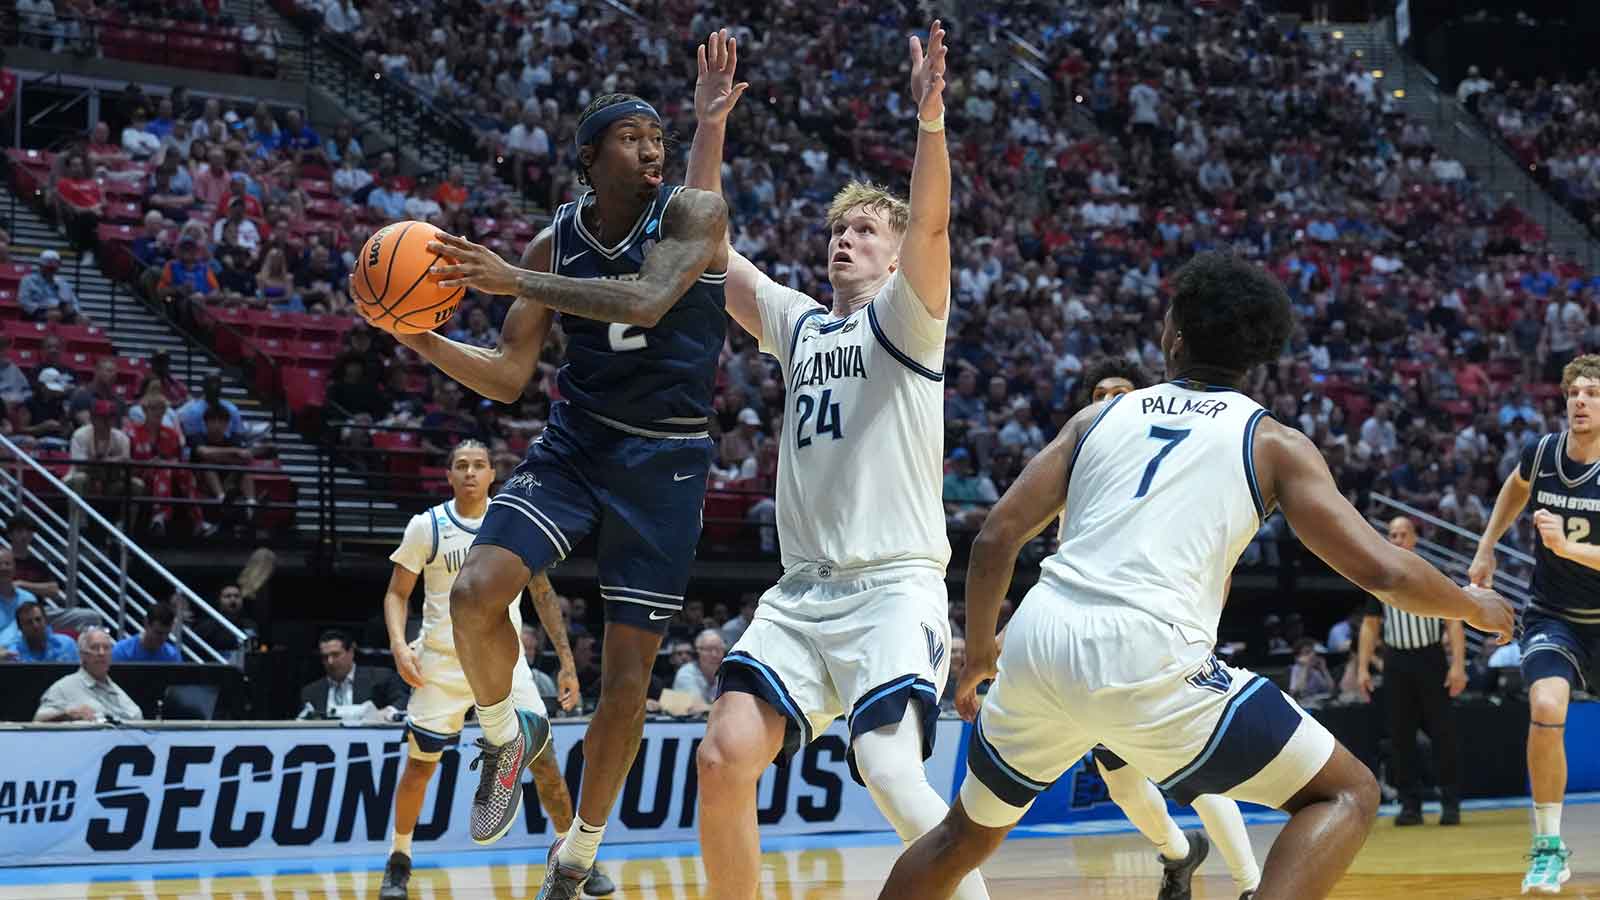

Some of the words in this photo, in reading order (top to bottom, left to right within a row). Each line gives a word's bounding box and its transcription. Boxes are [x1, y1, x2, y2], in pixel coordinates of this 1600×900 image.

[796, 388, 843, 449] 24
[1141, 395, 1228, 418] PALMER
[1133, 424, 1192, 499] 7
[1537, 490, 1567, 508] UTAH
[0, 780, 77, 824] AND
[86, 742, 461, 852] SECOND
[504, 734, 848, 837] UDS
